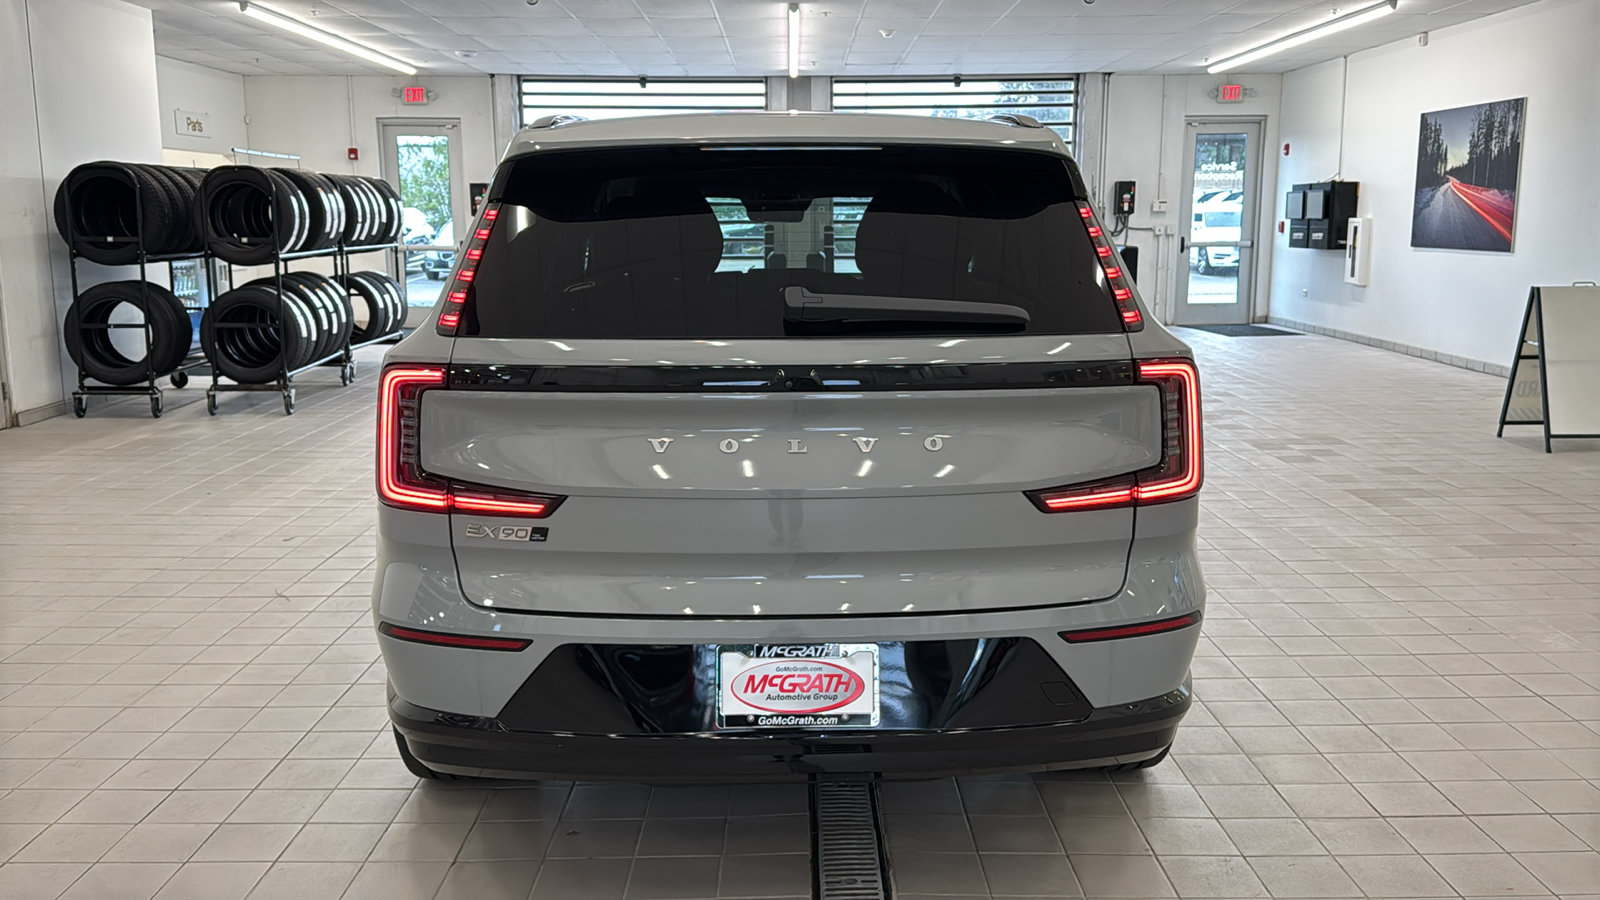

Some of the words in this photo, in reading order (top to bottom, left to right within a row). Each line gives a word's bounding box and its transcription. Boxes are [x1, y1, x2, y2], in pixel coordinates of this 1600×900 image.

[405, 87, 424, 102] EXIT
[1222, 85, 1241, 100] EXIT
[186, 117, 203, 132] Parts
[648, 436, 943, 454] VOLVO
[766, 693, 811, 701] Automotive
[813, 693, 838, 702] Group
[758, 715, 838, 726] GoMcGrath.com
